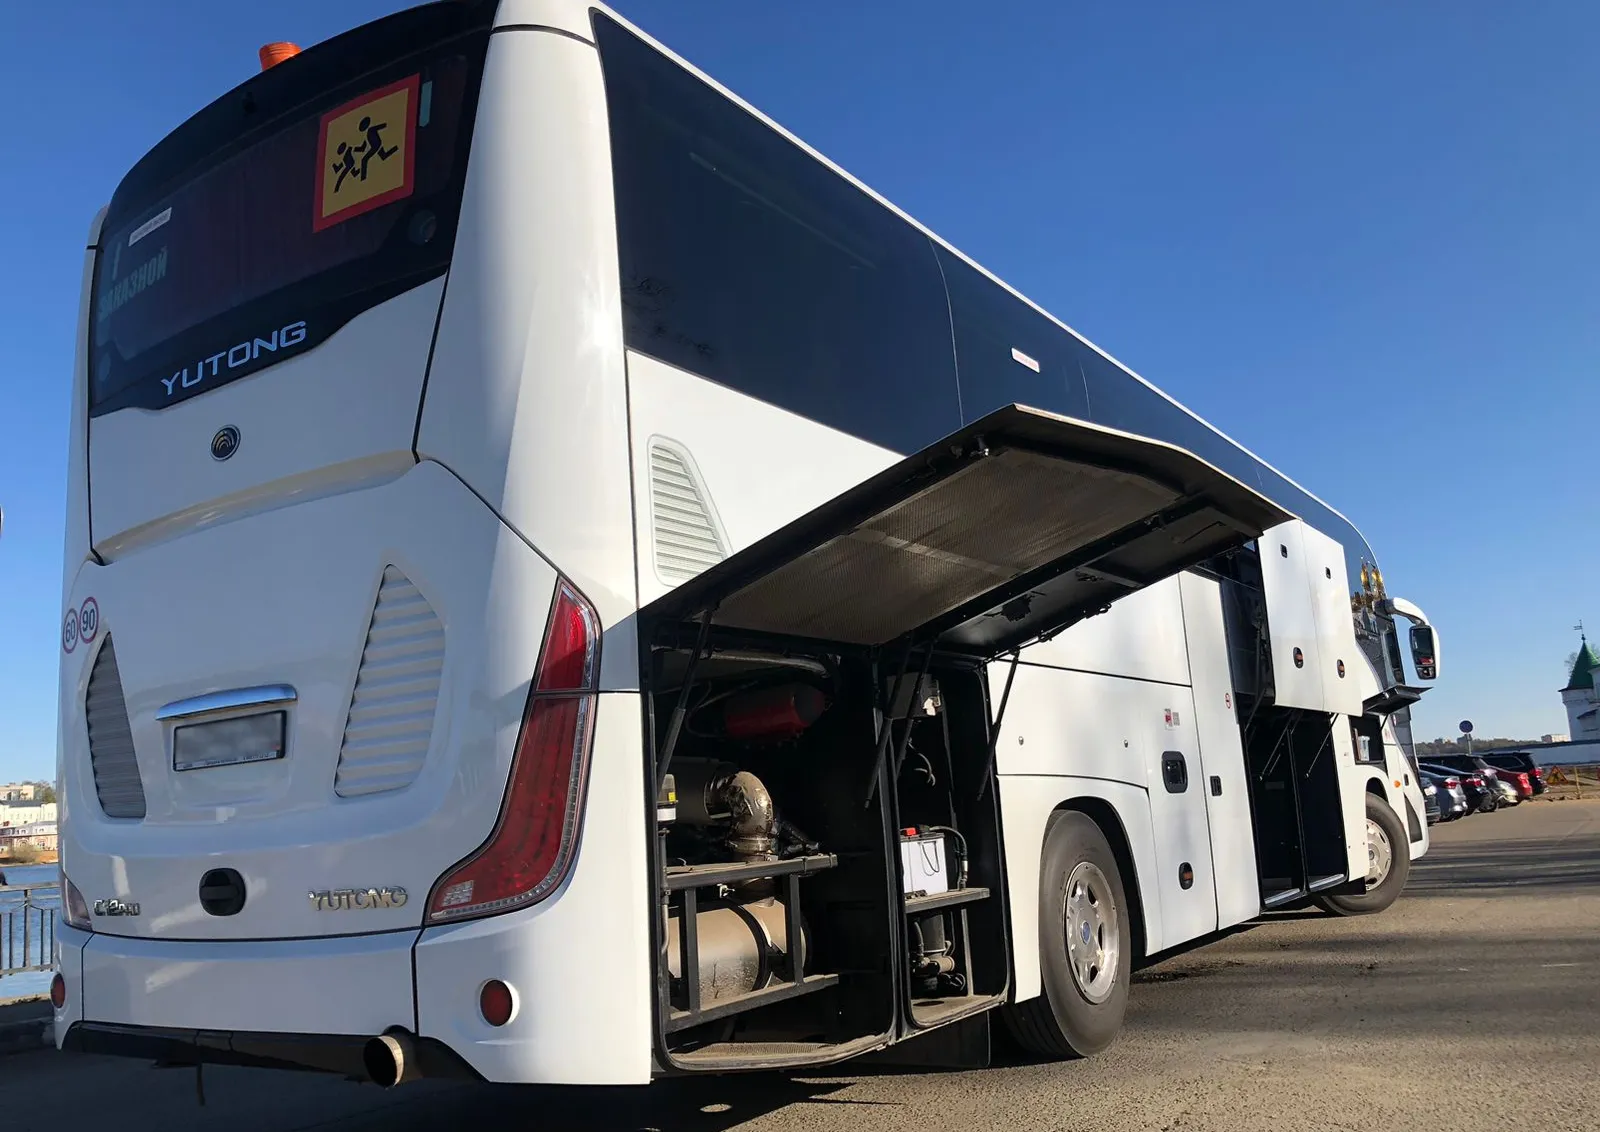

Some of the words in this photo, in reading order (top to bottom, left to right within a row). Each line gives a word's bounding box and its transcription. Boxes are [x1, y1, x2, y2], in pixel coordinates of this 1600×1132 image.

[160, 321, 306, 395] YUTONG
[65, 619, 76, 643] 60
[82, 609, 95, 632] 90
[308, 886, 408, 911] YUTONG
